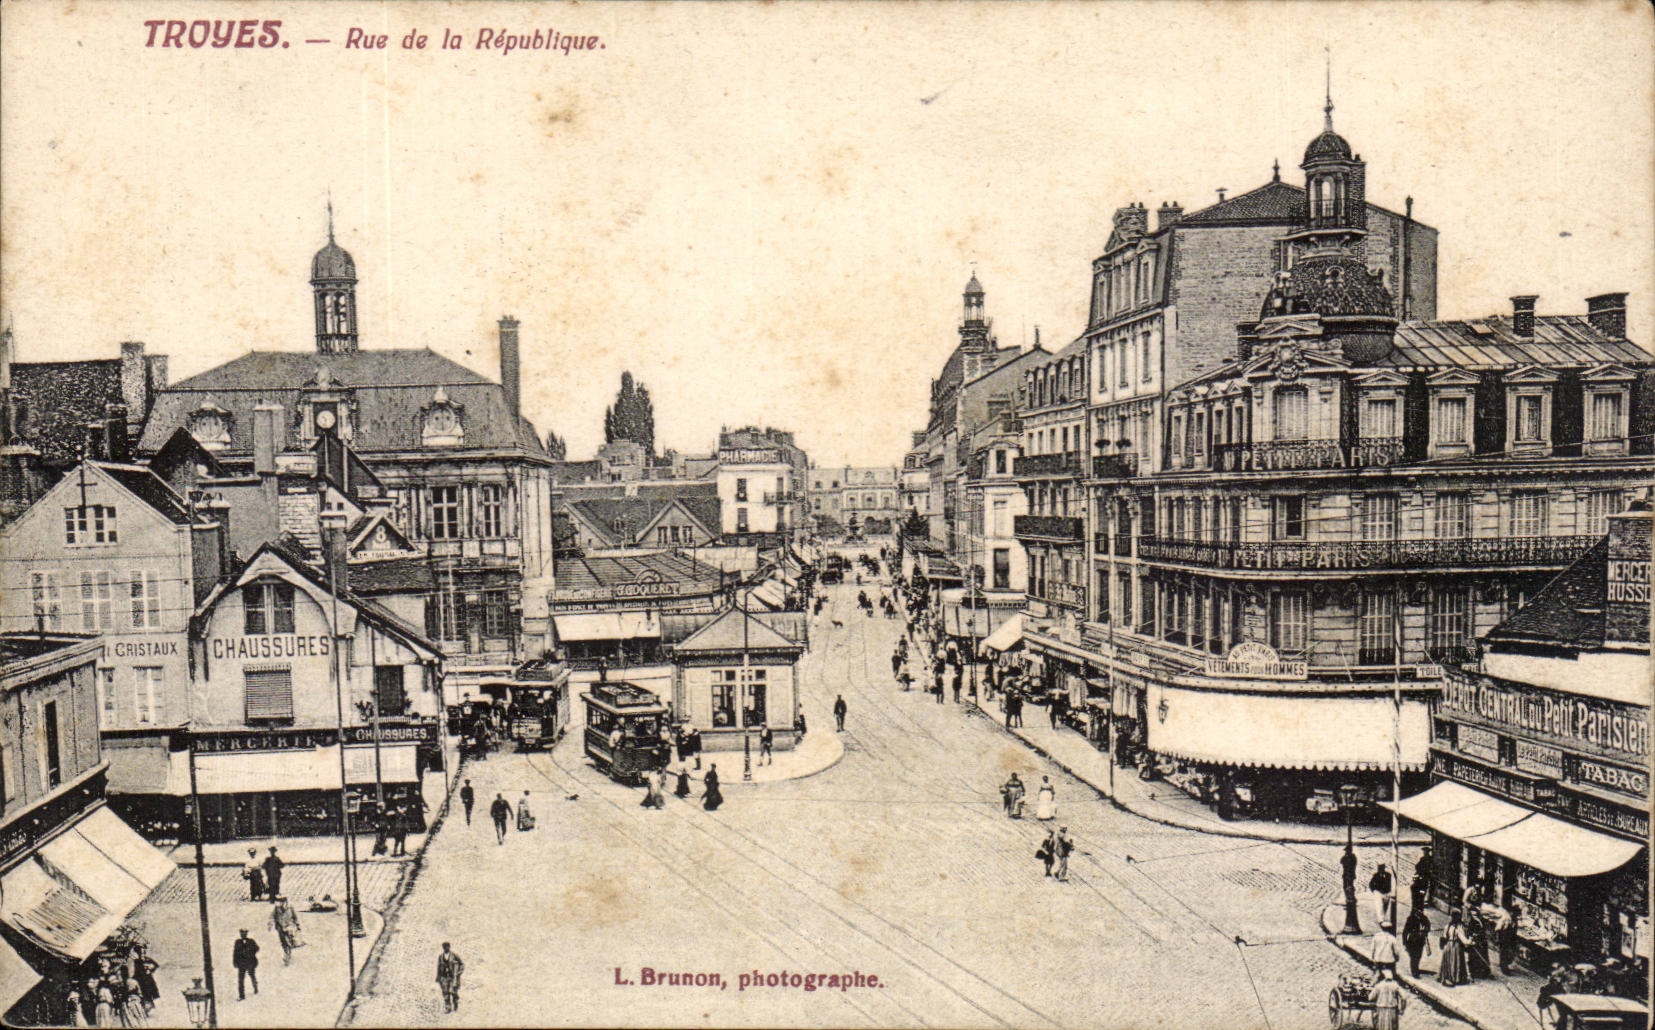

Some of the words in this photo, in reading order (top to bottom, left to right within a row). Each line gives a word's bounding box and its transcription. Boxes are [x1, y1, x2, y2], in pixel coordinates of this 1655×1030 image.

[719, 449, 778, 464] PHARMACIE
[1314, 446, 1390, 469] PARIS
[1301, 549, 1371, 569] PARIS
[115, 642, 178, 657] CRISTAUX
[213, 635, 330, 660] CHAUSSURES
[1265, 662, 1304, 676] HOMMES
[1478, 686, 1528, 729] CENTRAL
[1543, 694, 1574, 738] Petit
[1577, 702, 1650, 756] Parisien
[196, 735, 317, 752] MERCERIE
[1581, 761, 1645, 793] TABAC
